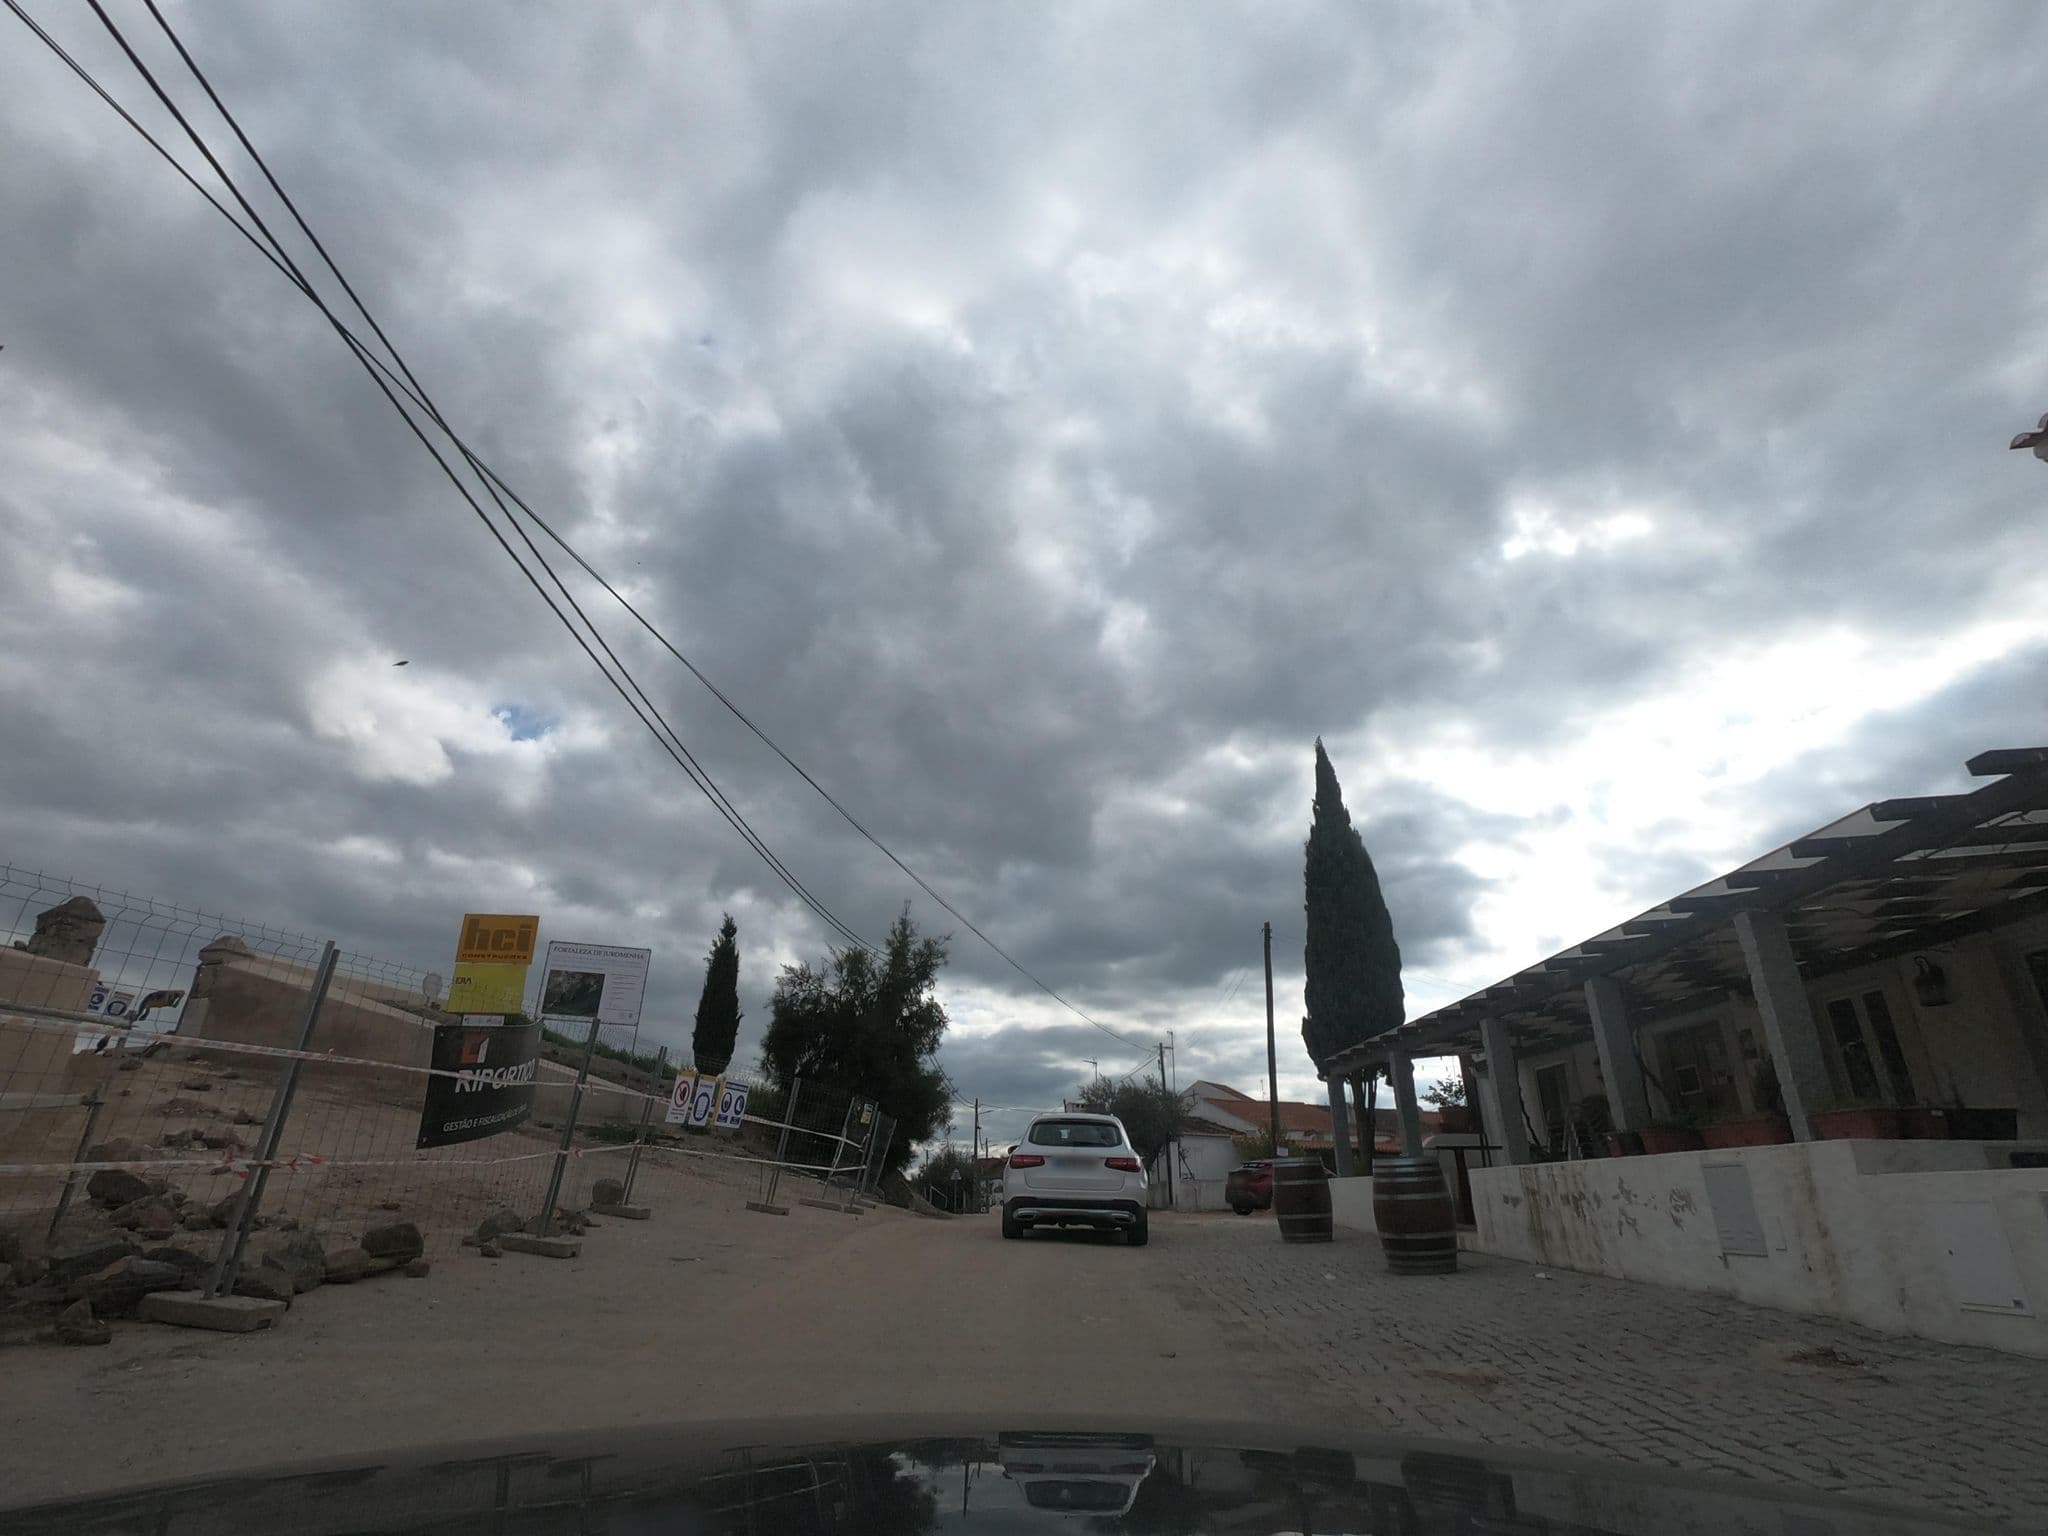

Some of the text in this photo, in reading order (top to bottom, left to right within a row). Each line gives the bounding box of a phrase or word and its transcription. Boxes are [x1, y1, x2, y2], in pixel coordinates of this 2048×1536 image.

[463, 918, 533, 952] hci
[553, 946, 592, 955] FORTALEZA
[443, 1118, 472, 1132] GESTÃO
[473, 1118, 479, 1127] E
